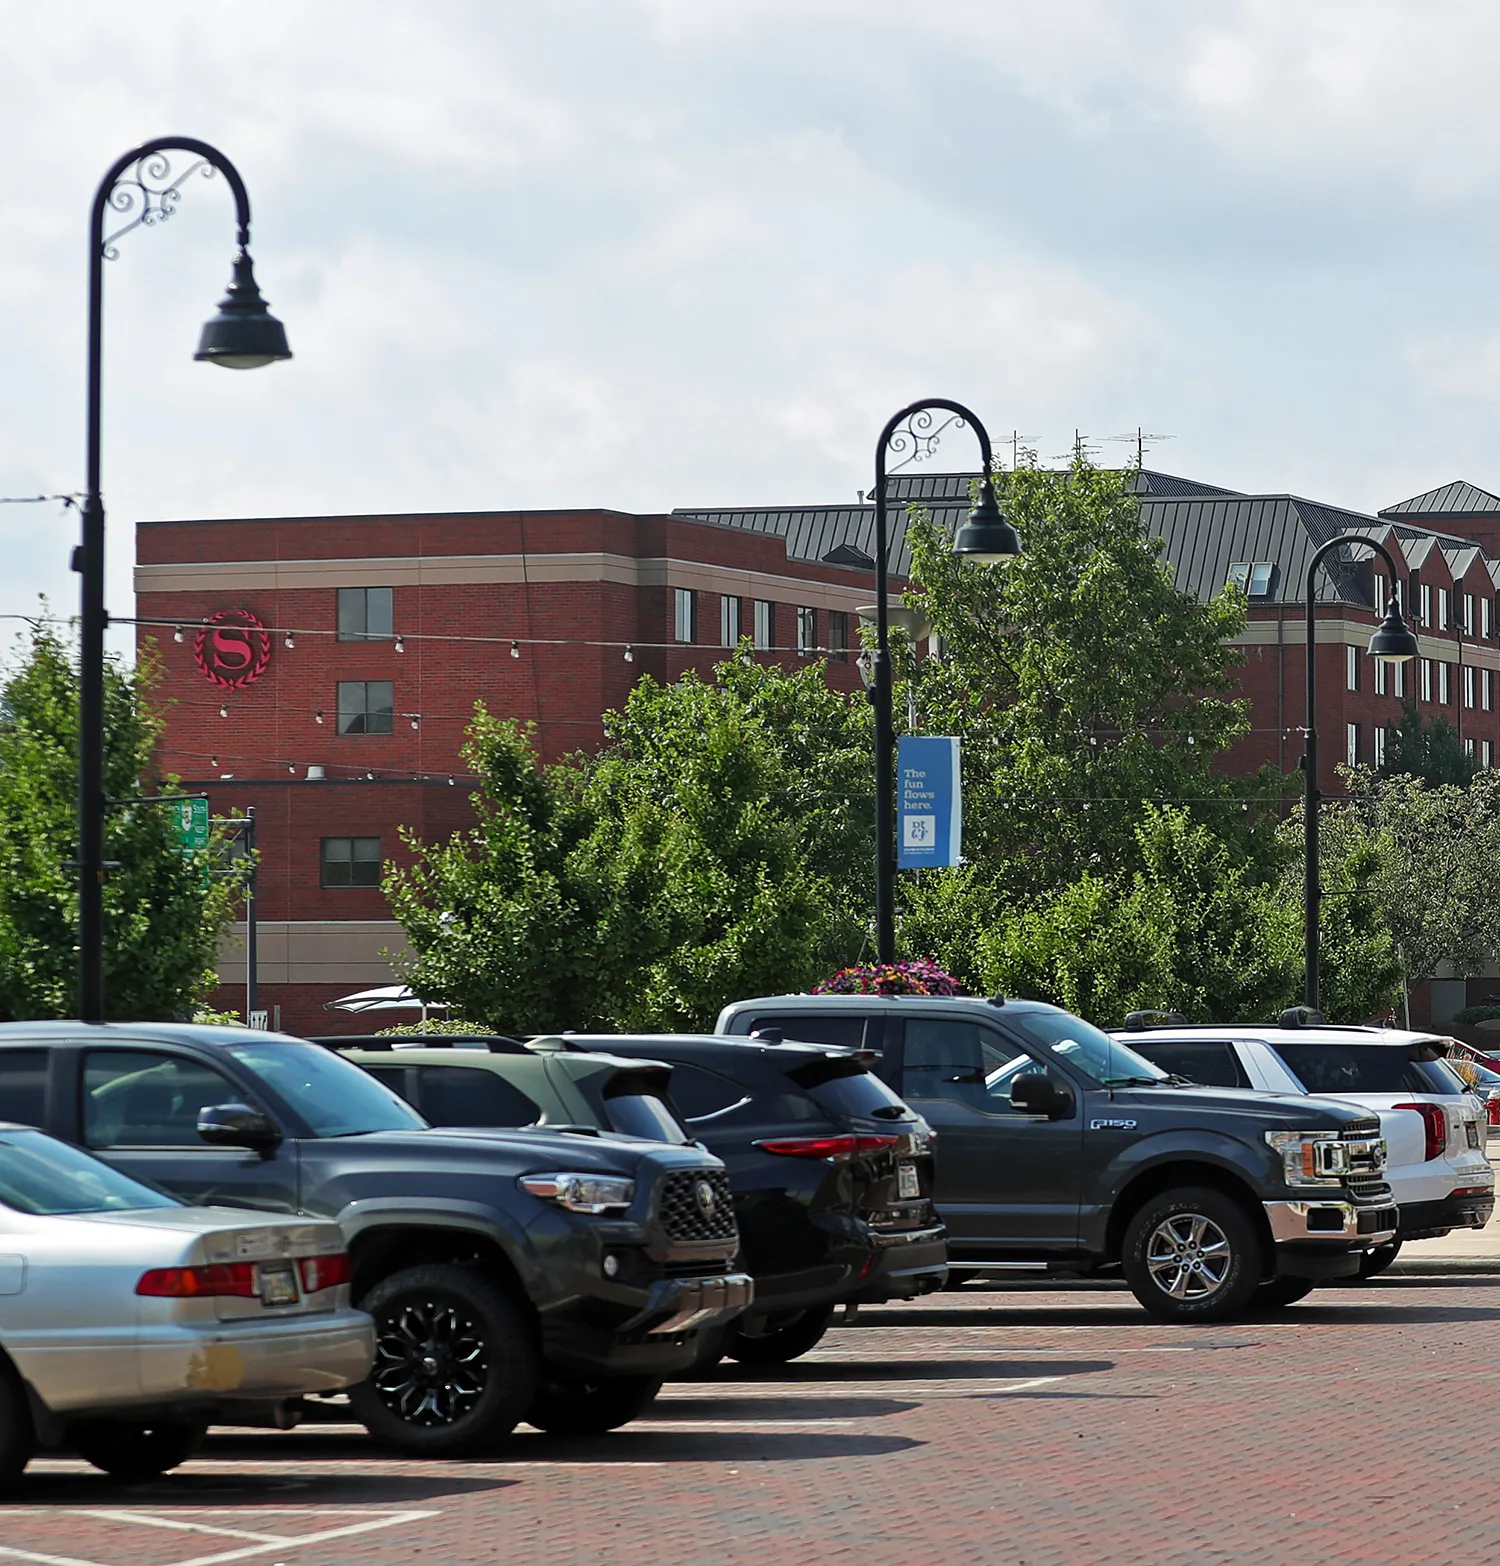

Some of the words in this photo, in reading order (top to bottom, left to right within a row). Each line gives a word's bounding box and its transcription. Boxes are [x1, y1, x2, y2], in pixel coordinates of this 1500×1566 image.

[213, 625, 252, 670] S
[903, 769, 926, 778] The
[904, 779, 924, 789] fun
[904, 789, 935, 799] flows
[903, 800, 933, 810] here.
